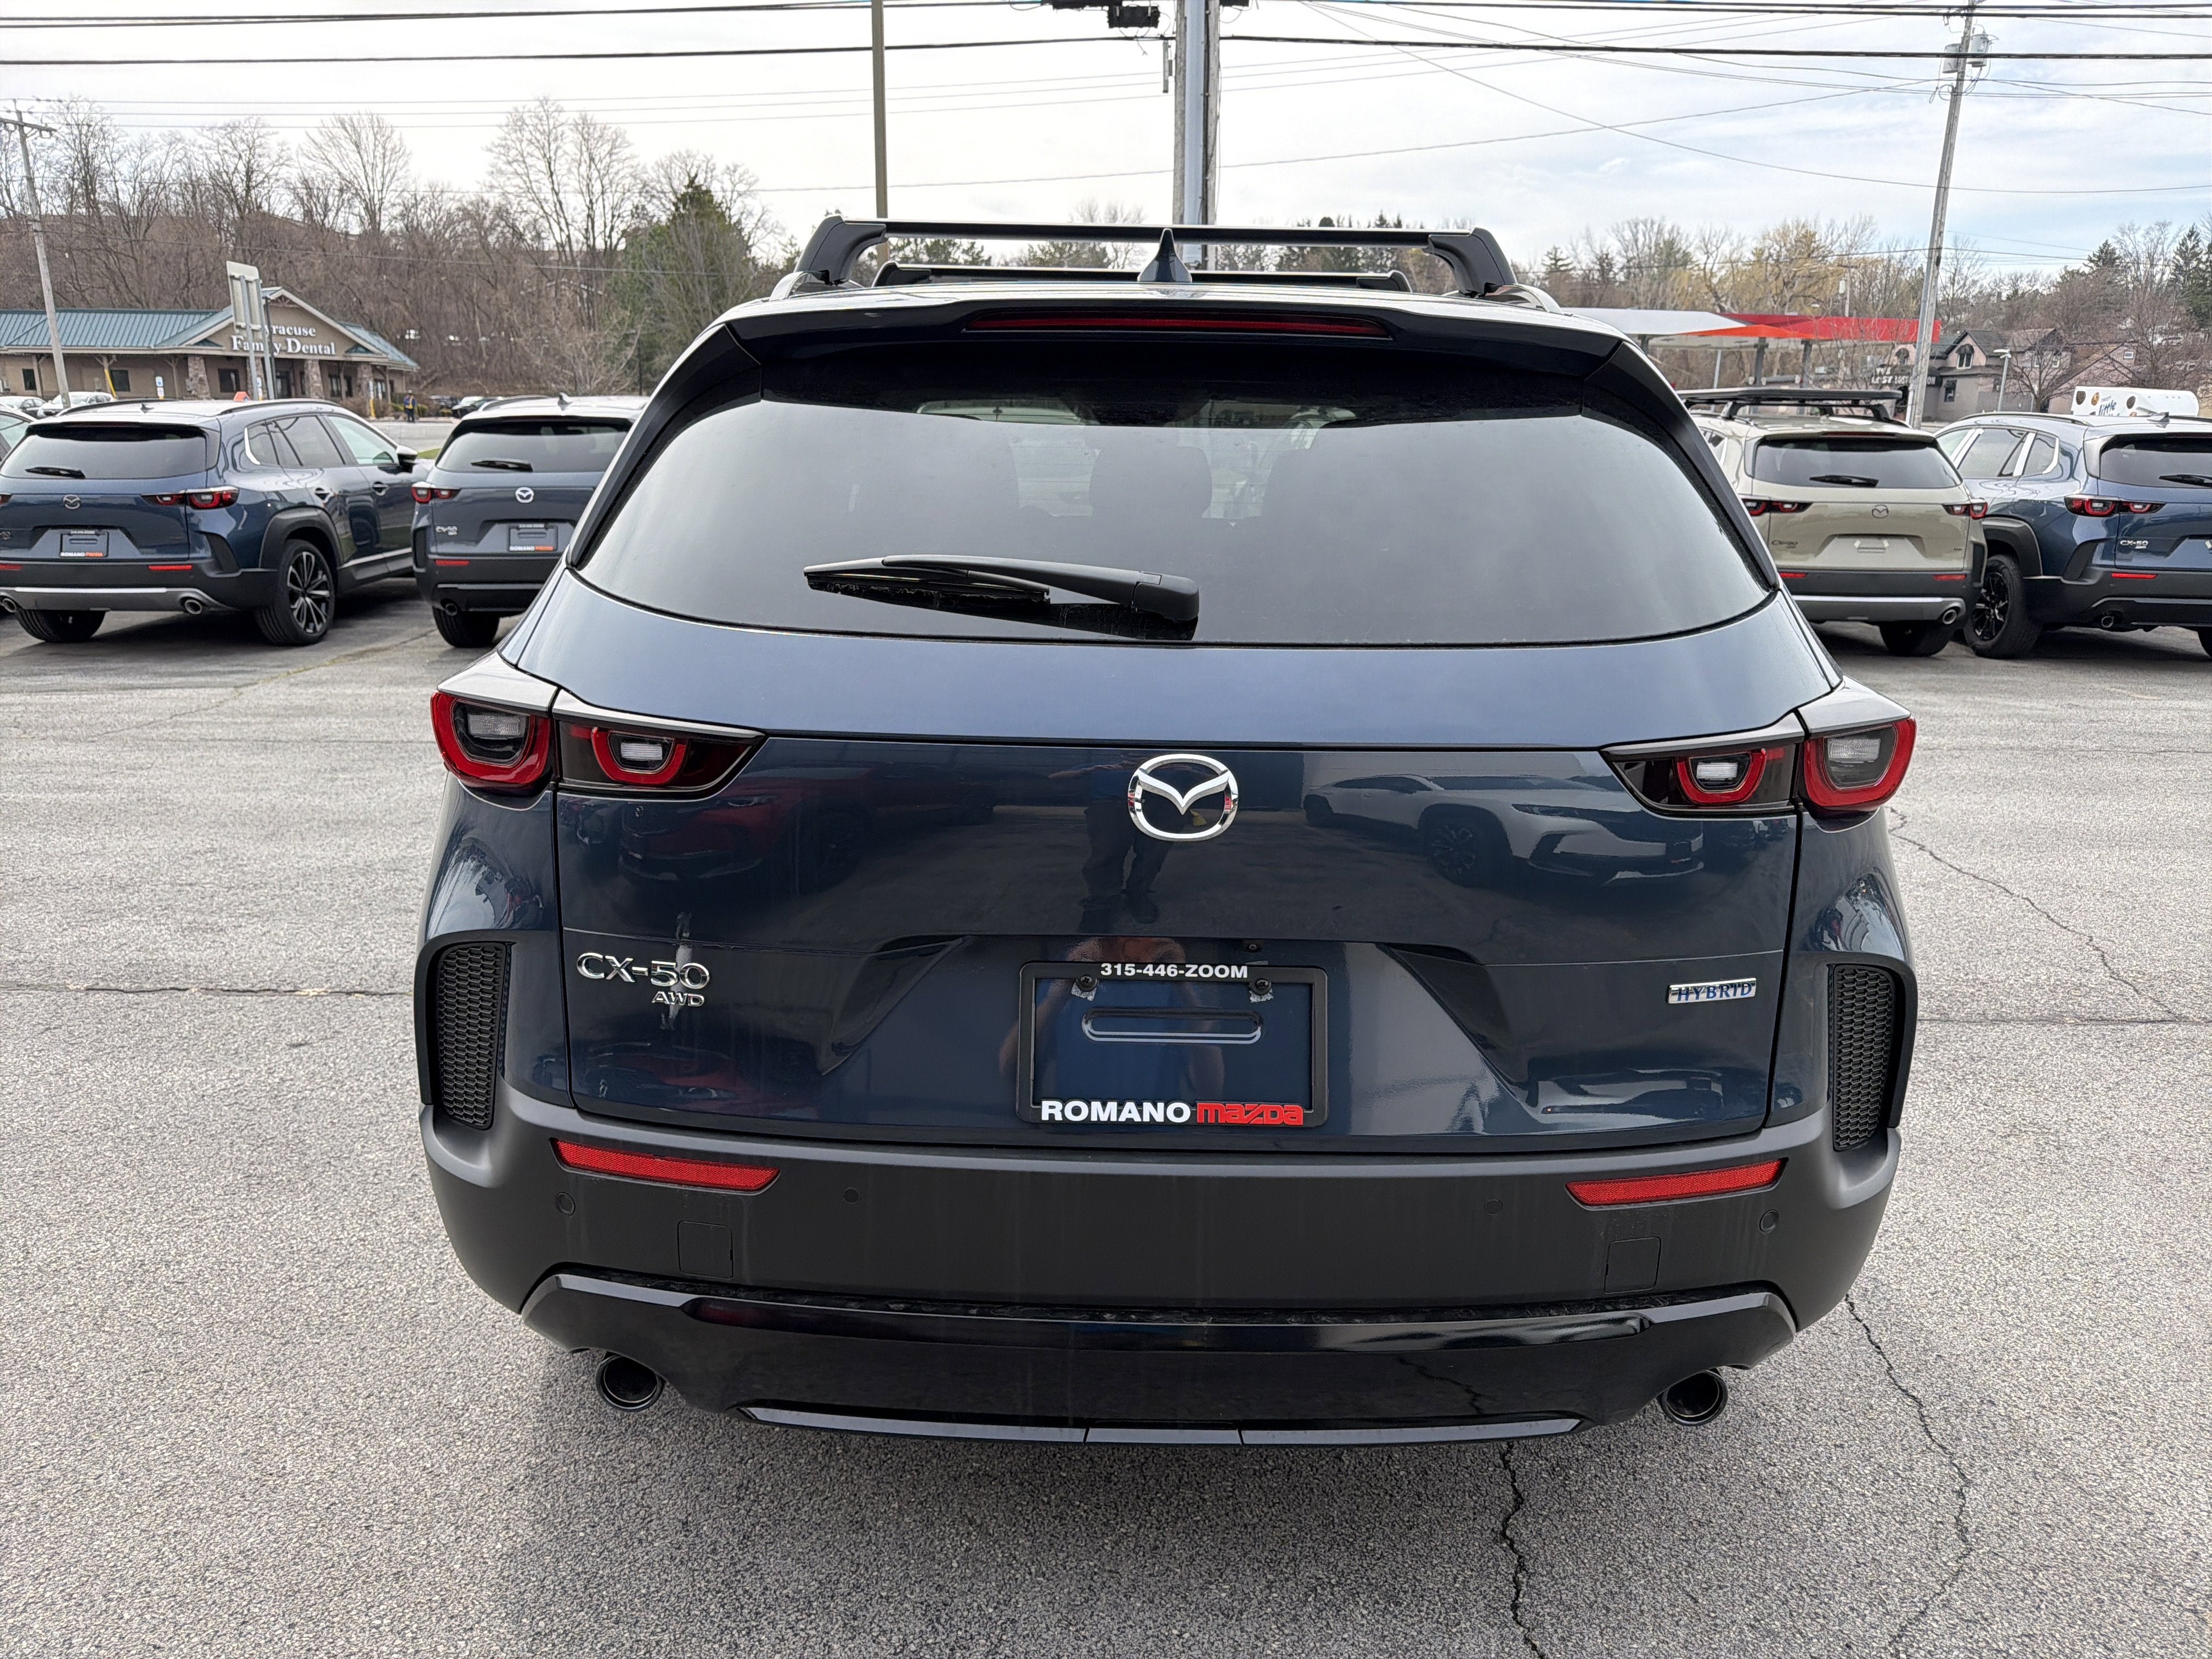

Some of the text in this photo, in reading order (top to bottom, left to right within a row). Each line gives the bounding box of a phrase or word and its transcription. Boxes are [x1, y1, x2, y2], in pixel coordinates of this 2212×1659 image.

[231, 335, 336, 356] Famy Dental
[577, 952, 710, 990] CX-50
[1101, 963, 1248, 979] 315-446-ZOOM
[651, 991, 705, 1007] AWD
[1677, 982, 1752, 1001] HYBRID
[1042, 1100, 1191, 1123] ROMANO
